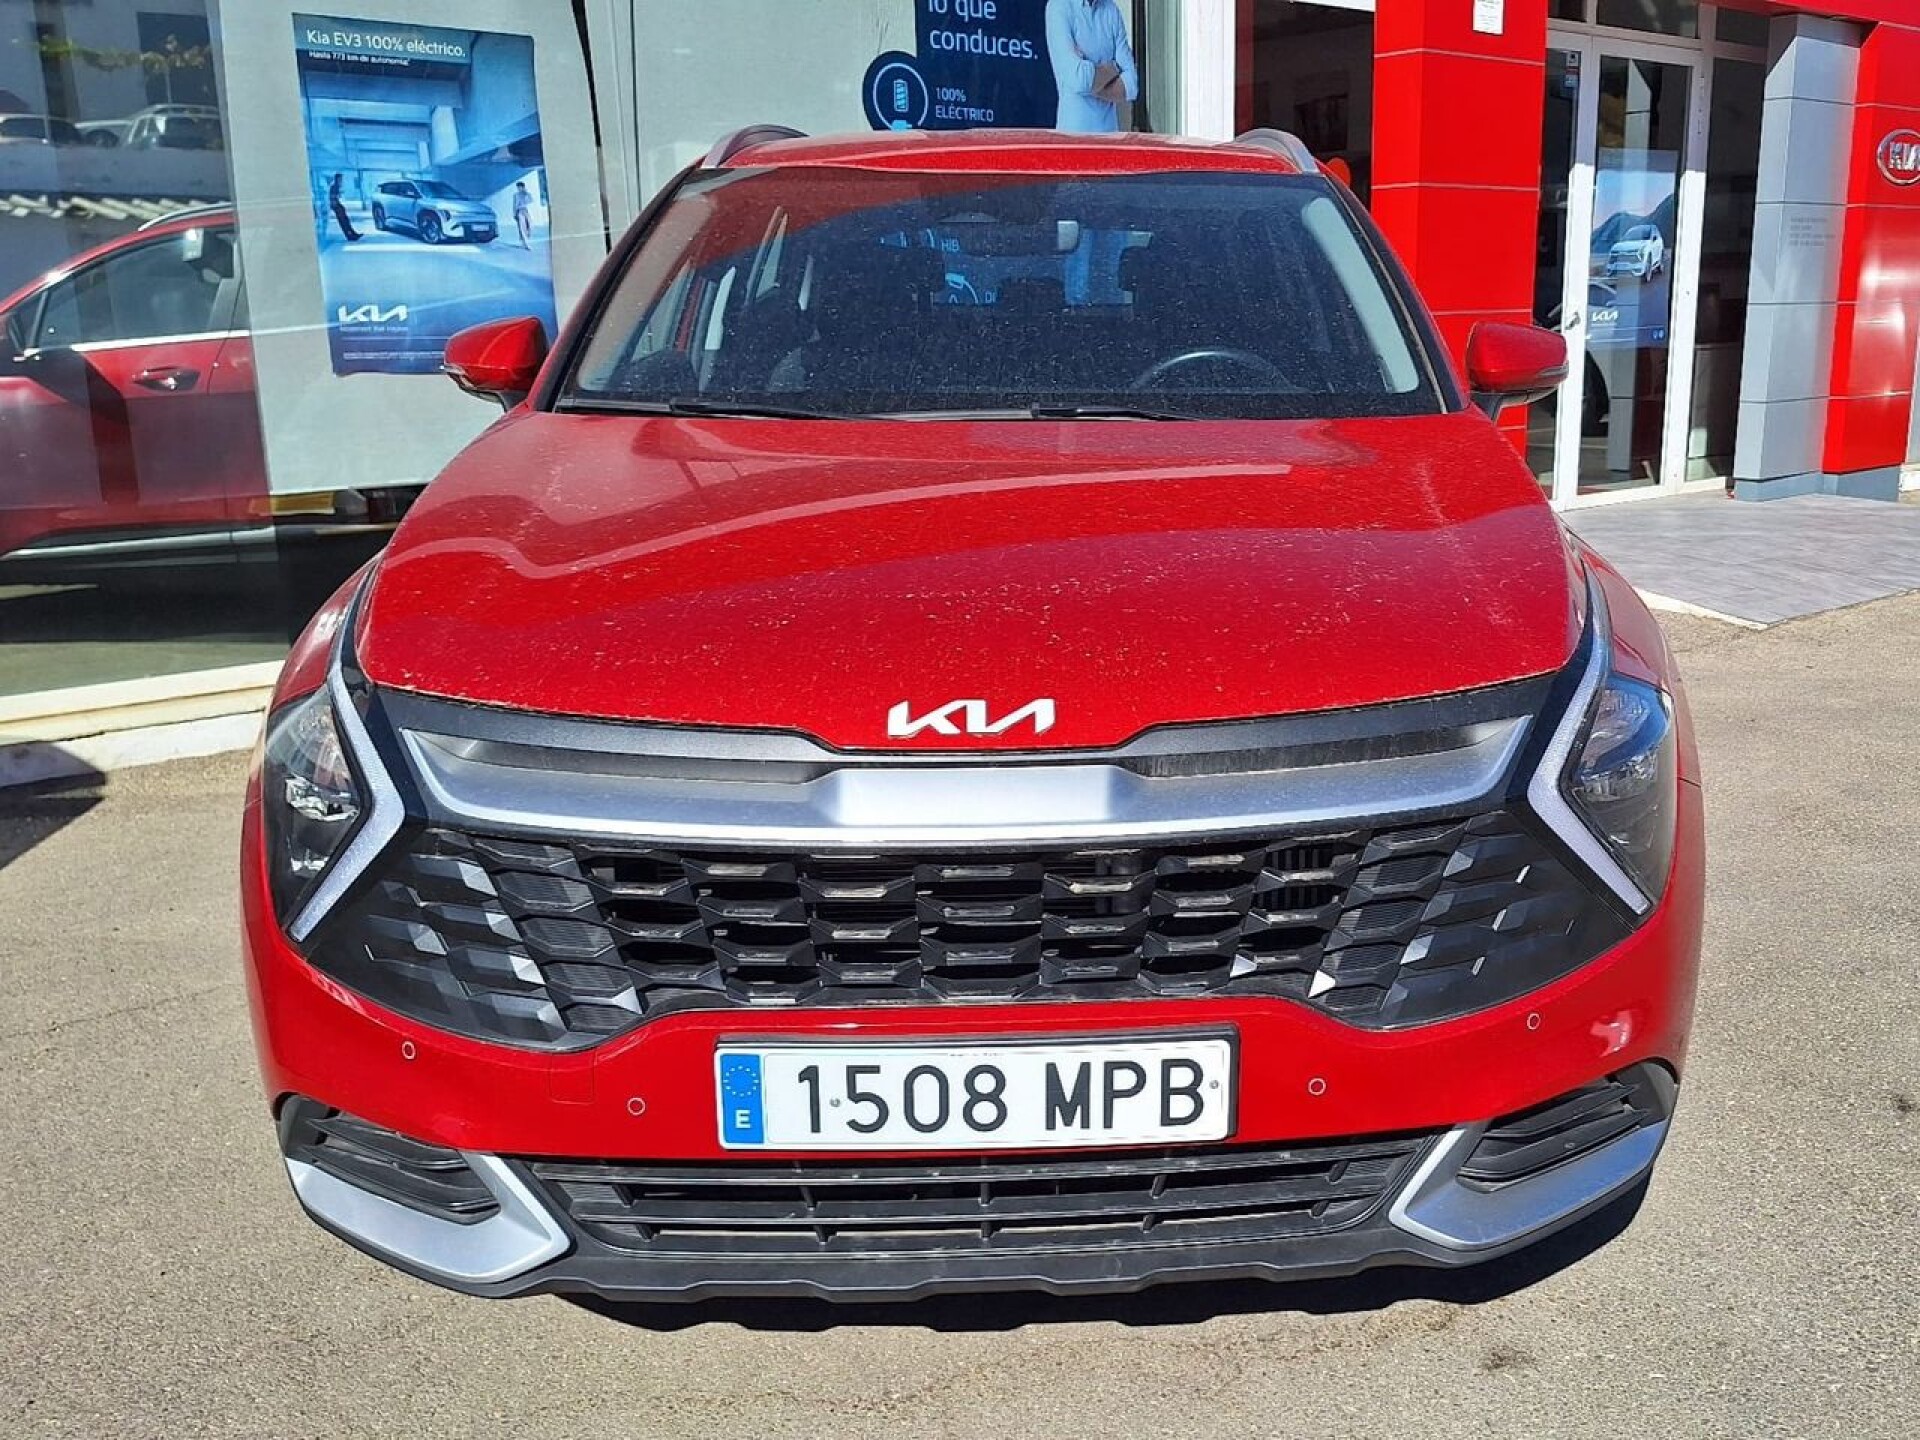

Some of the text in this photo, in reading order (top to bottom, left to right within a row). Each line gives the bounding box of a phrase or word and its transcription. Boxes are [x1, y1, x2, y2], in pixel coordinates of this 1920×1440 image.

[928, 0, 997, 22] lo que
[307, 29, 466, 58] Kia EV3 100% eléctrico.
[929, 28, 1039, 59] conduces.
[935, 87, 967, 103] 100%
[935, 103, 994, 122] ELÉCTRICO
[338, 304, 407, 322] KIA
[1592, 310, 1618, 322] KIA
[887, 698, 1056, 738] KIA
[797, 1058, 1205, 1134] 1508 MPB
[734, 1109, 752, 1129] E
